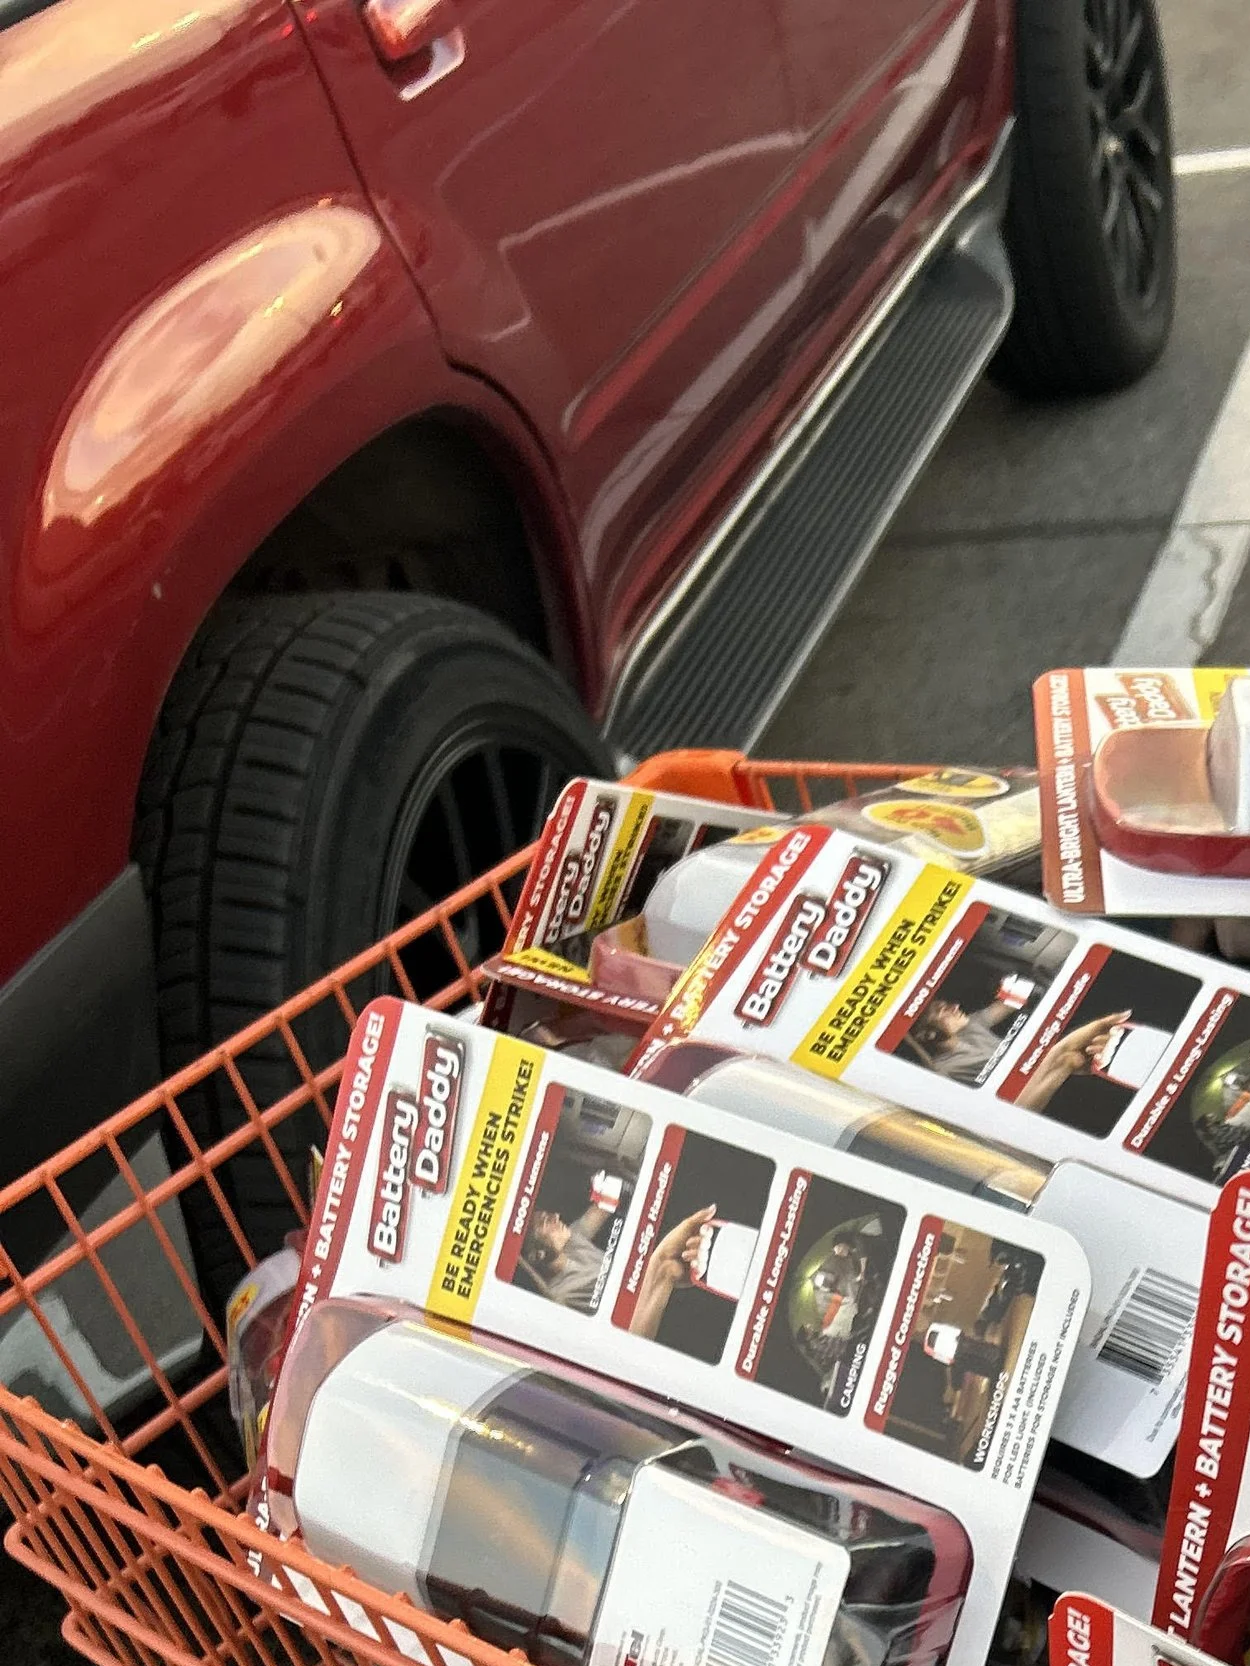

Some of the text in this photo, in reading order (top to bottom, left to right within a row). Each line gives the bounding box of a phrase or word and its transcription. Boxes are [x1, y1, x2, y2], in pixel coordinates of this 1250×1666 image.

[732, 829, 812, 931] STORAGE!
[805, 861, 884, 971] Daddy
[740, 901, 830, 1022] Battery
[808, 916, 915, 1056] BE READY WHEN
[825, 878, 961, 1063] EMERGENCIES STRIKE!
[414, 1043, 459, 1183] Daddy
[974, 1012, 1028, 1084] EMERGENCIES
[311, 1012, 386, 1260] BATTERY STORAGE!
[371, 1099, 422, 1254] Battery
[440, 1110, 502, 1292] BE READY WHEN
[456, 1057, 535, 1299] EMERGENCIES STRIKE!
[511, 1129, 551, 1235] 1000 Lumens
[588, 1216, 624, 1309] EMERGENCIES
[624, 1161, 673, 1292] Non-Slip Handle
[738, 1175, 811, 1373] Durable & Long-Lasting
[837, 1341, 869, 1409] CAMPING
[870, 1231, 938, 1415] Rugged Construction
[971, 1370, 1012, 1465] WORKSHOPS
[1170, 1500, 1211, 1627] LANTERN
[1195, 1342, 1239, 1478] BATTERY
